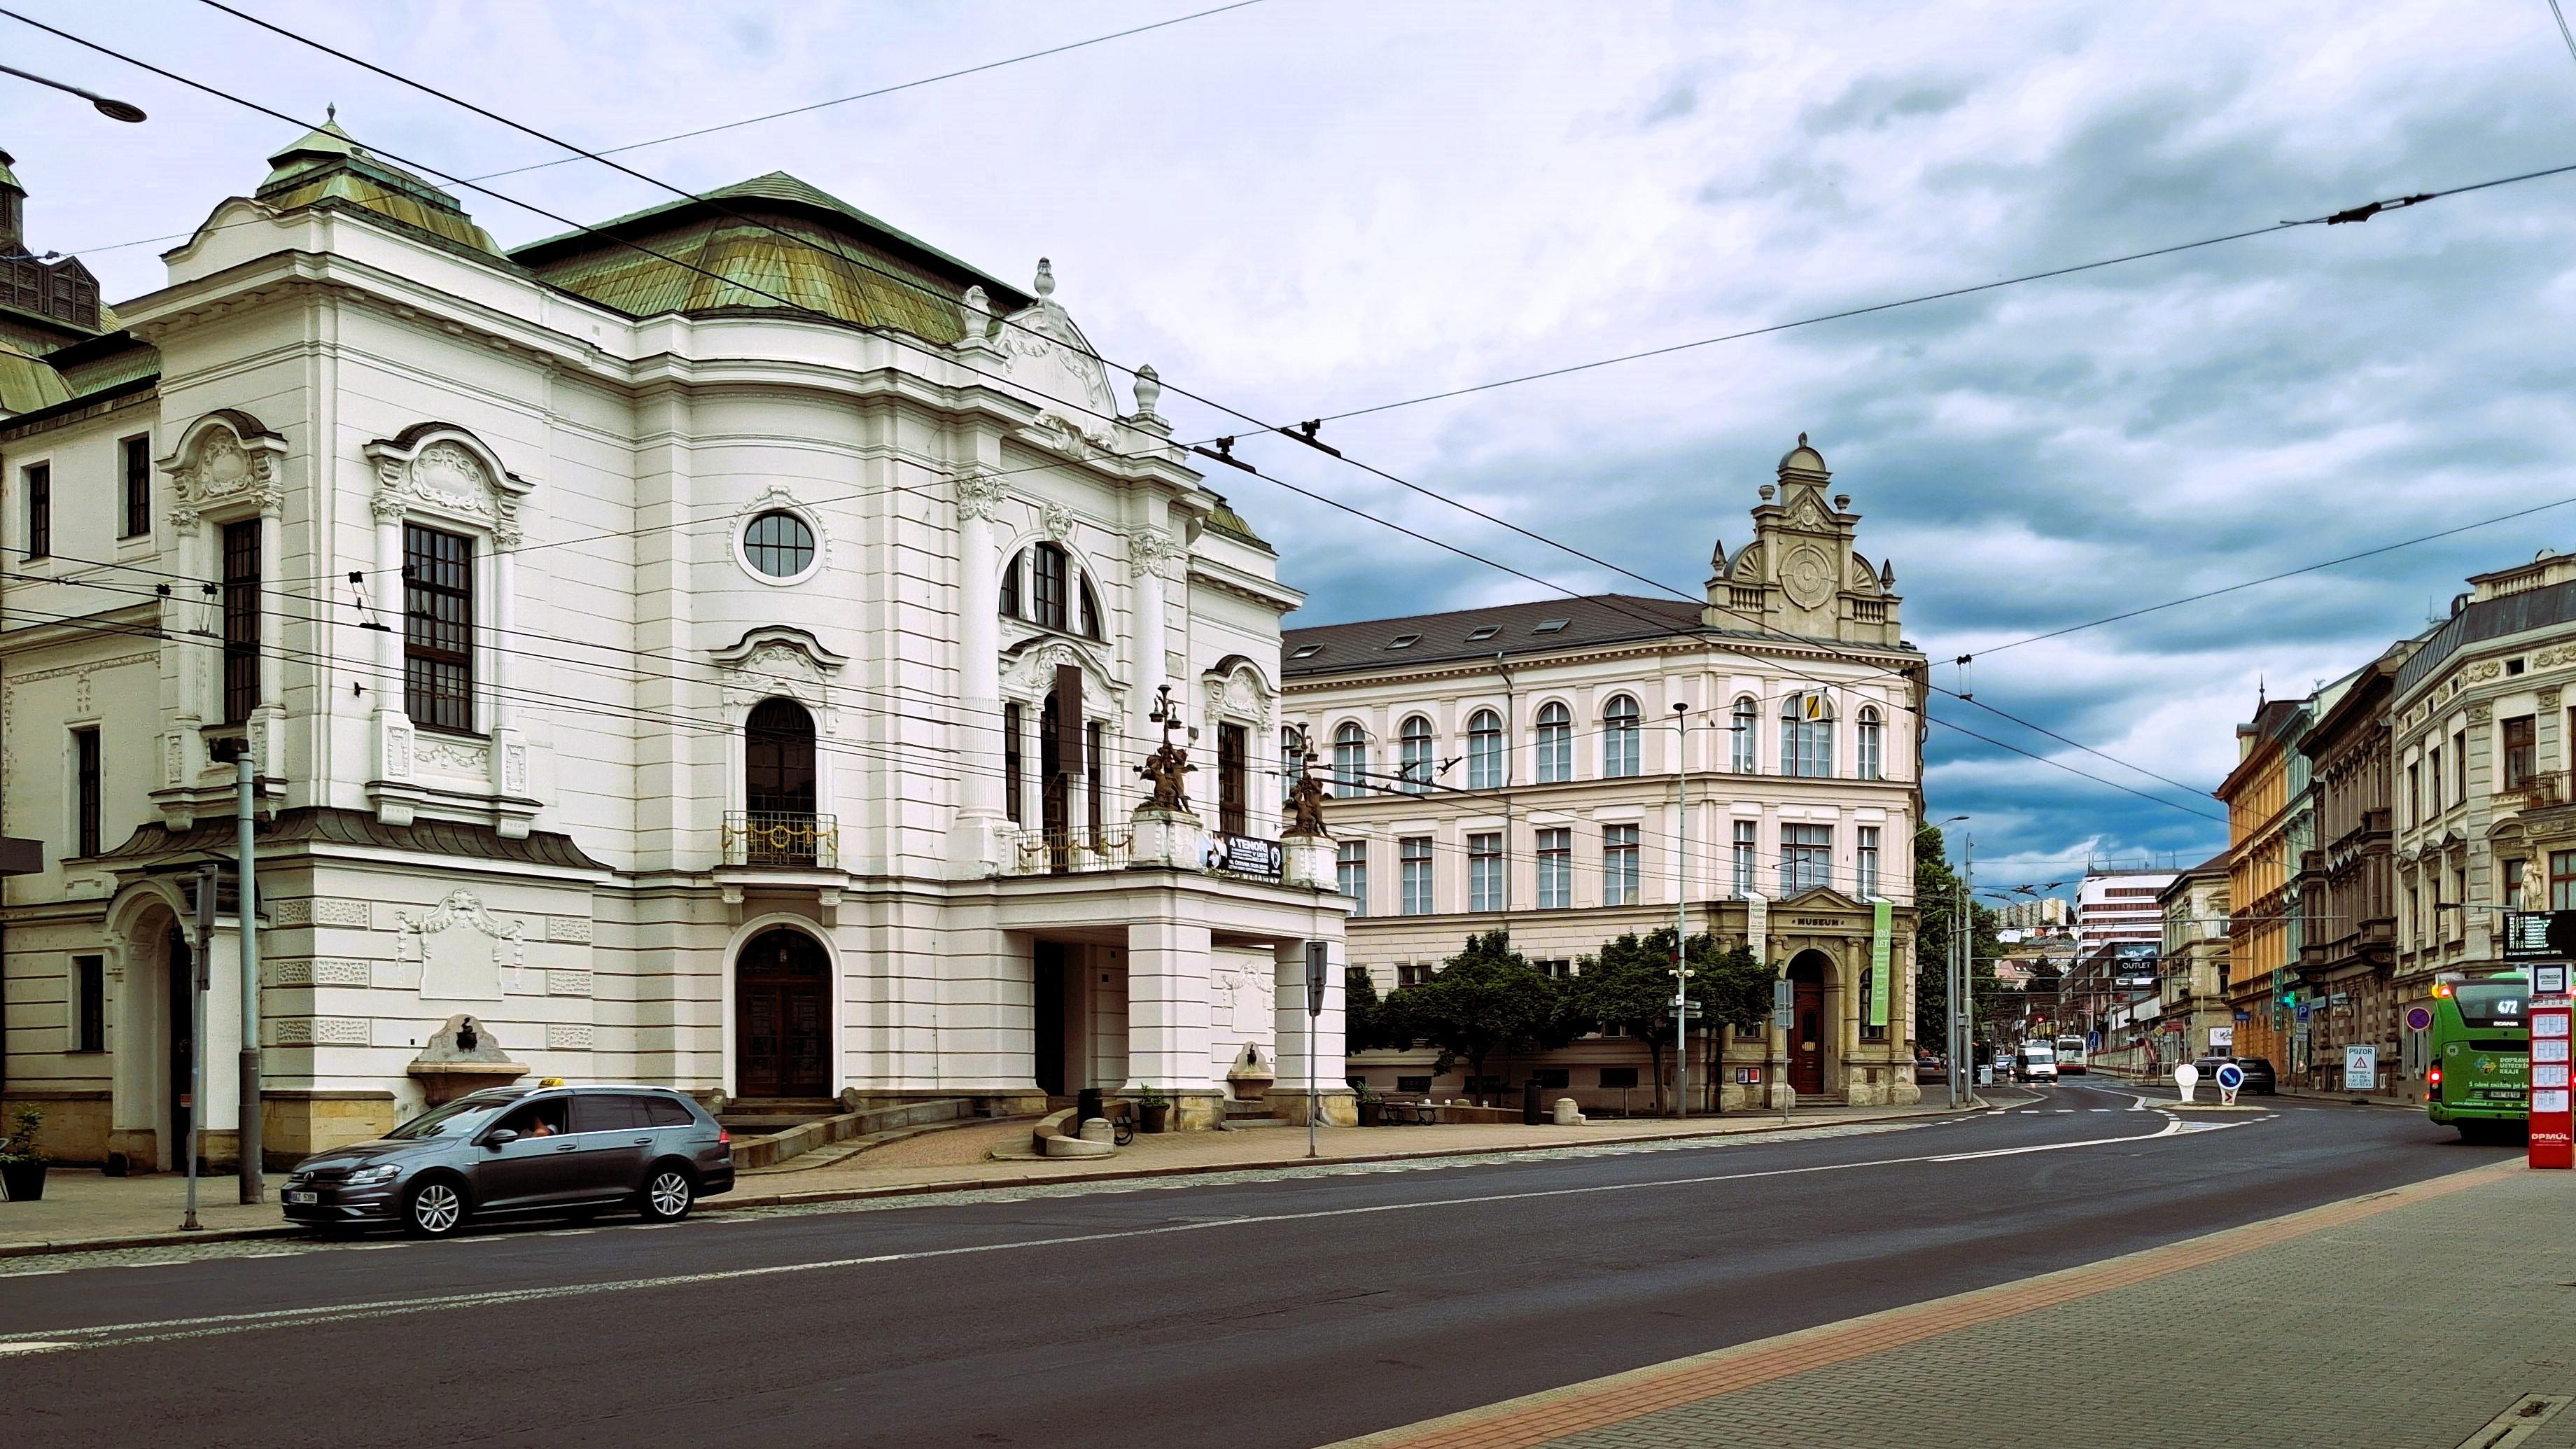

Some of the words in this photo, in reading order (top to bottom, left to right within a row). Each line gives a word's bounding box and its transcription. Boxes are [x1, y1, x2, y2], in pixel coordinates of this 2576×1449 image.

[1229, 837, 1236, 847] 4
[1236, 839, 1268, 853] TENOŘI
[1877, 929, 1889, 938] 100
[2498, 1000, 2517, 1014] 472
